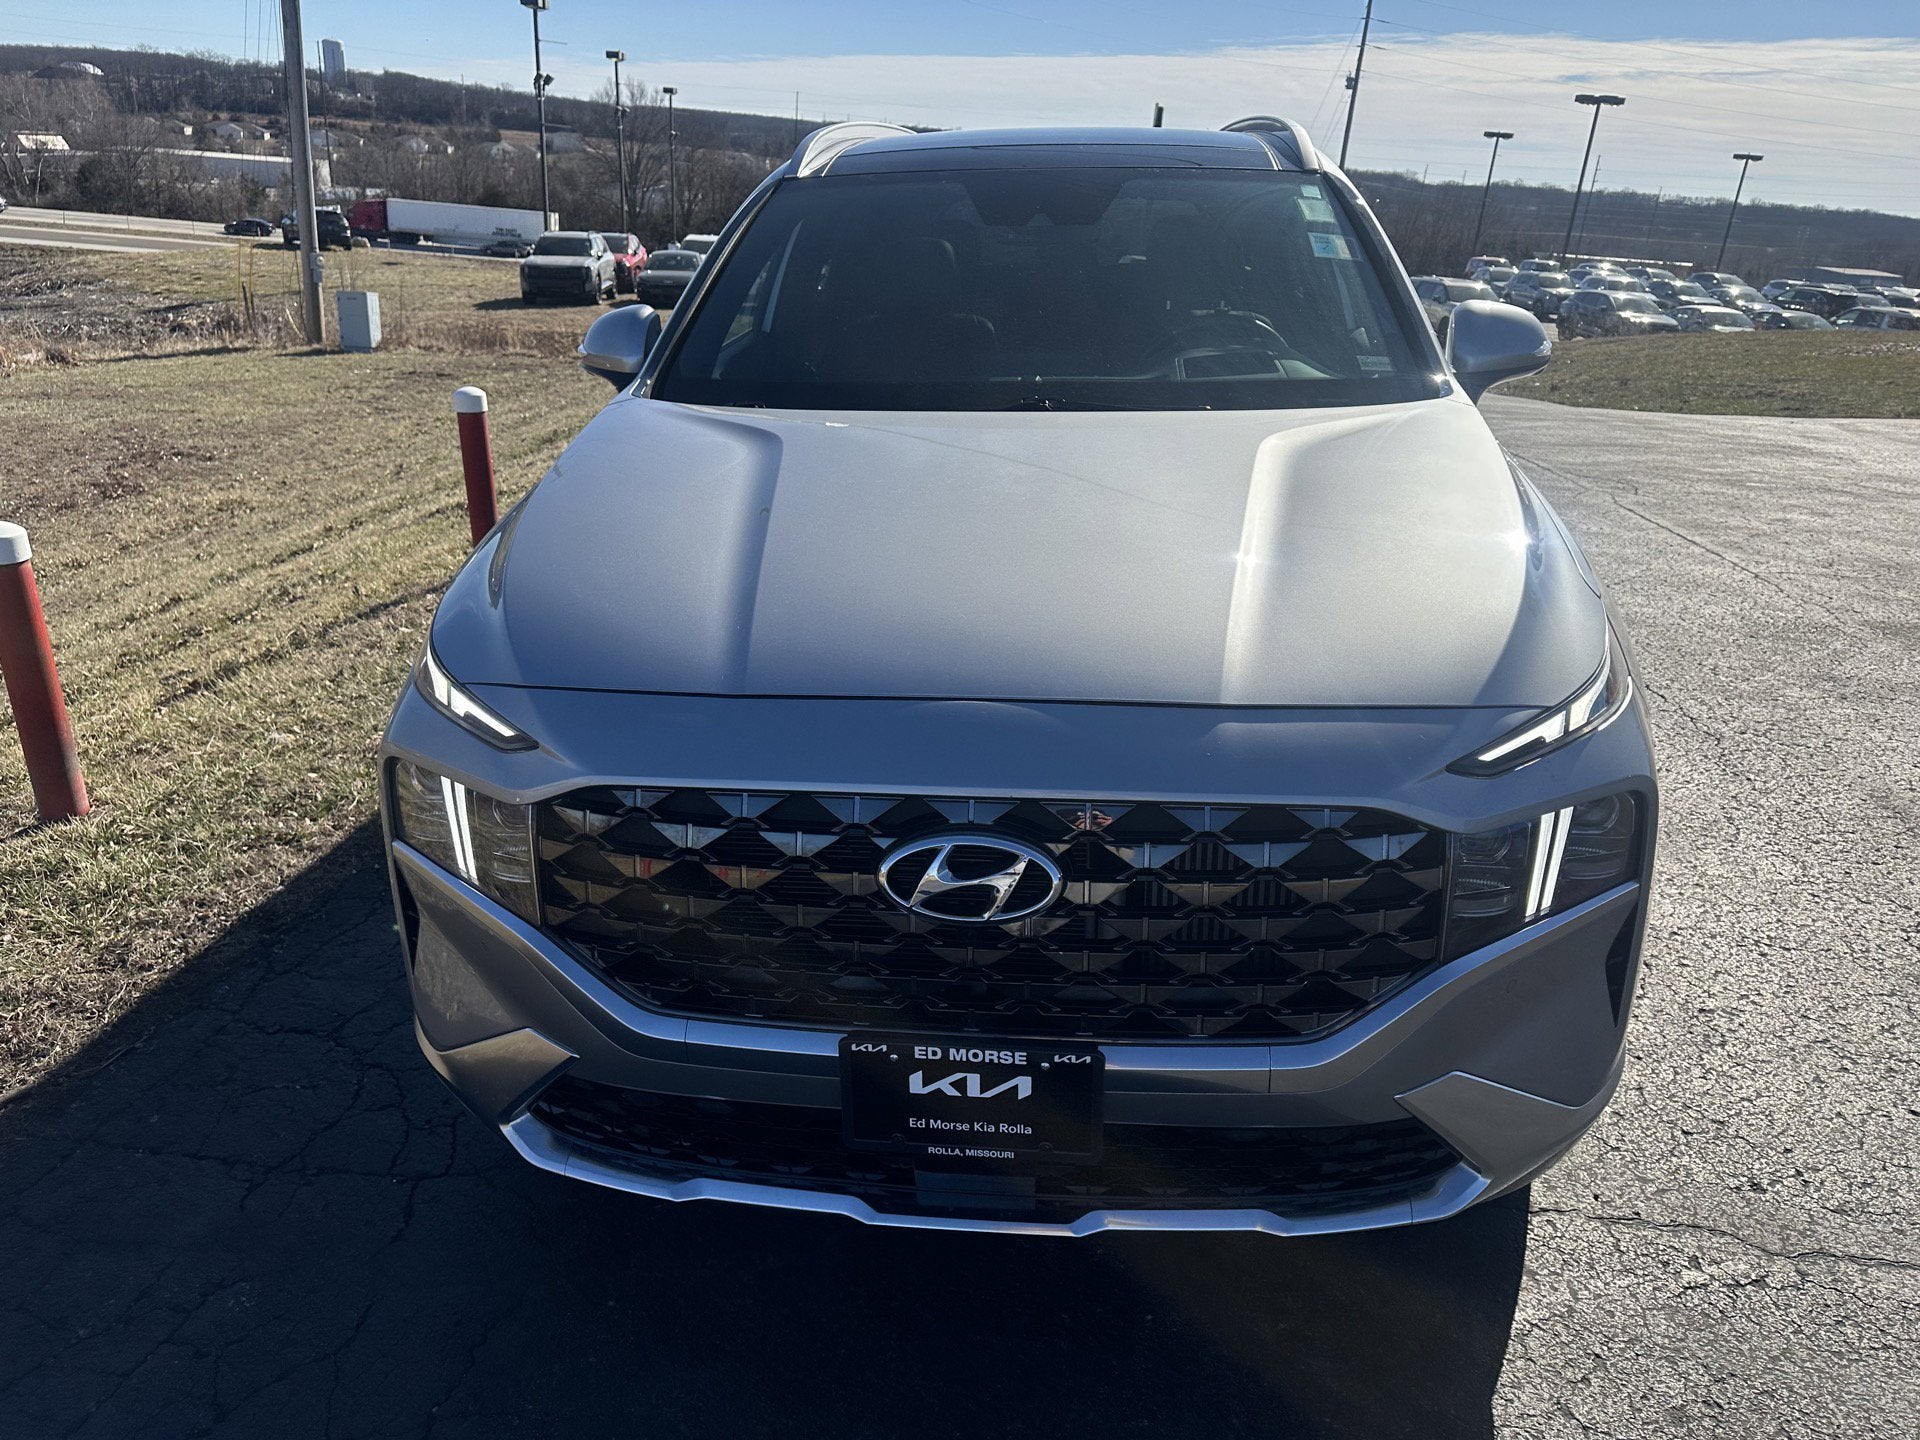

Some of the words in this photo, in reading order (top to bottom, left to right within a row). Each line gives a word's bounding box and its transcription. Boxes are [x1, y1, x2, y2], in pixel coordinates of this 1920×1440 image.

[851, 1043, 888, 1053] KIA
[914, 1046, 942, 1060] ED
[949, 1048, 1028, 1065] MORSE
[1054, 1054, 1092, 1064] KIA
[909, 1070, 1032, 1100] KIA
[909, 1117, 926, 1129] Ed
[929, 1119, 970, 1132] Morse
[974, 1121, 995, 1133] Kia
[999, 1123, 1032, 1135] Rolla
[928, 1146, 963, 1157] ROLLA,
[965, 1148, 1015, 1159] MISSOURI
